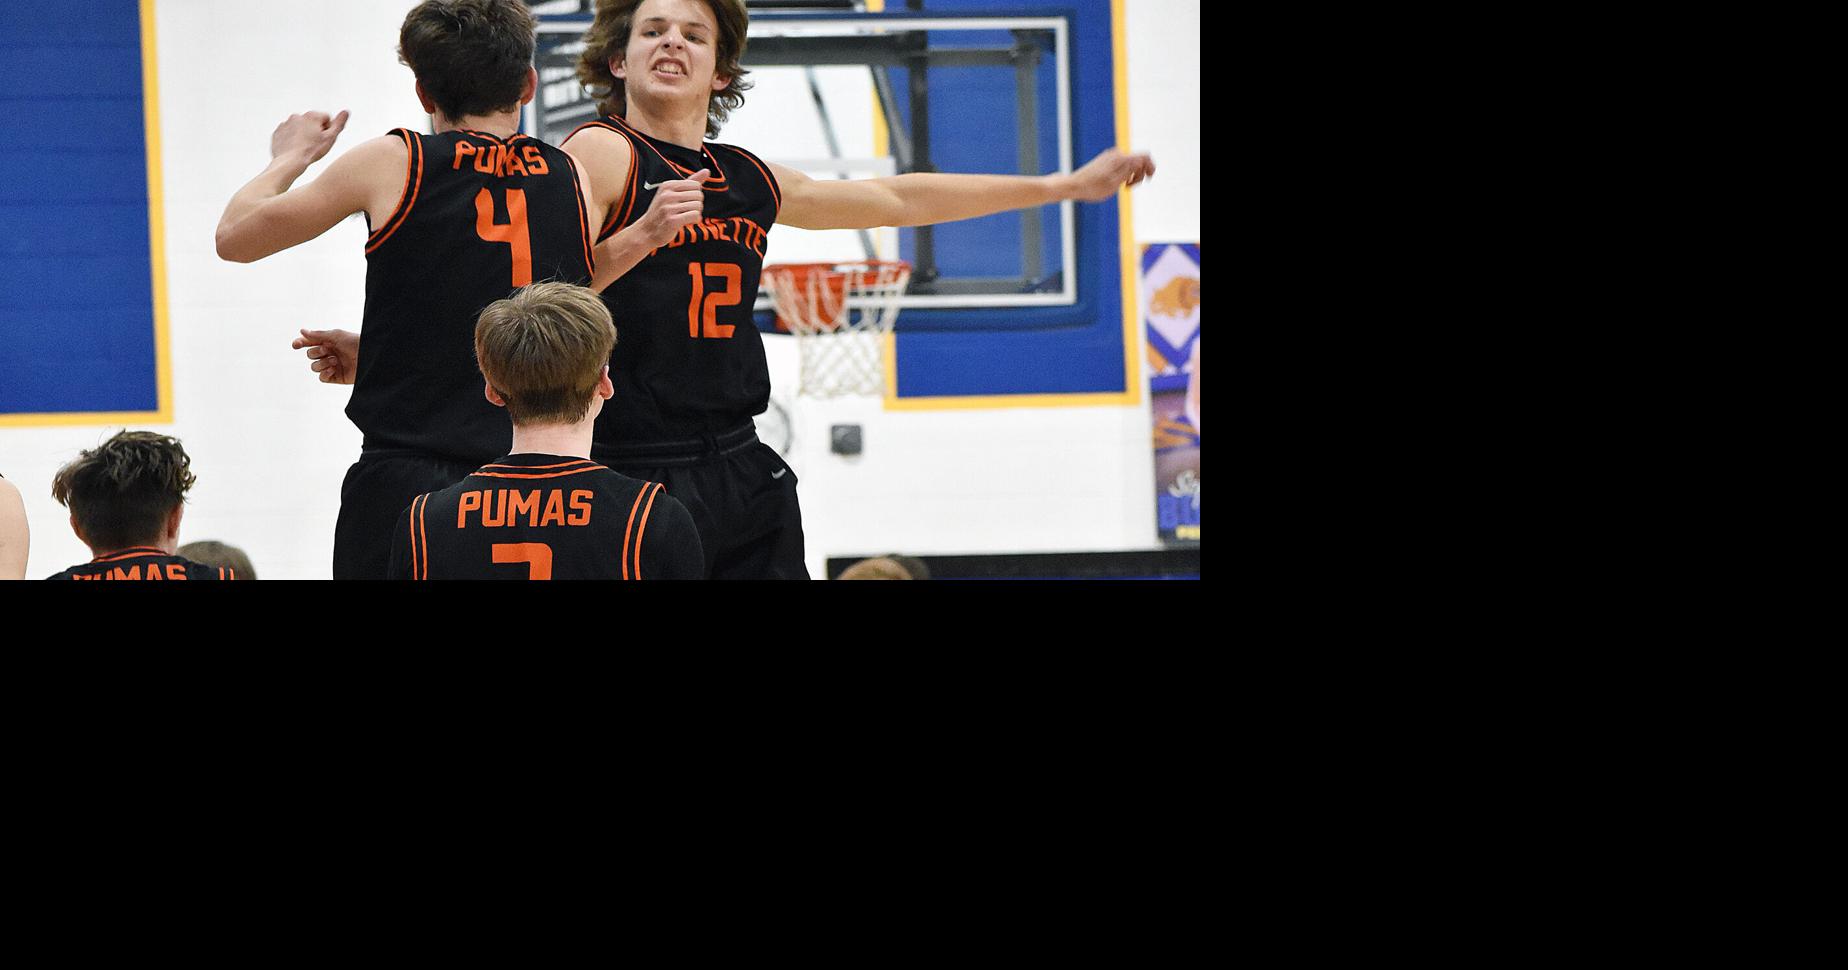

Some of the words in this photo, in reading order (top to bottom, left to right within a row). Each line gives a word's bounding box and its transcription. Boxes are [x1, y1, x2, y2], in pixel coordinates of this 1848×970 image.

[452, 140, 549, 177] PUMAS
[475, 187, 533, 288] 4
[651, 216, 767, 259] OYNETTE
[688, 262, 742, 338] 12
[457, 489, 594, 529] PUMAS
